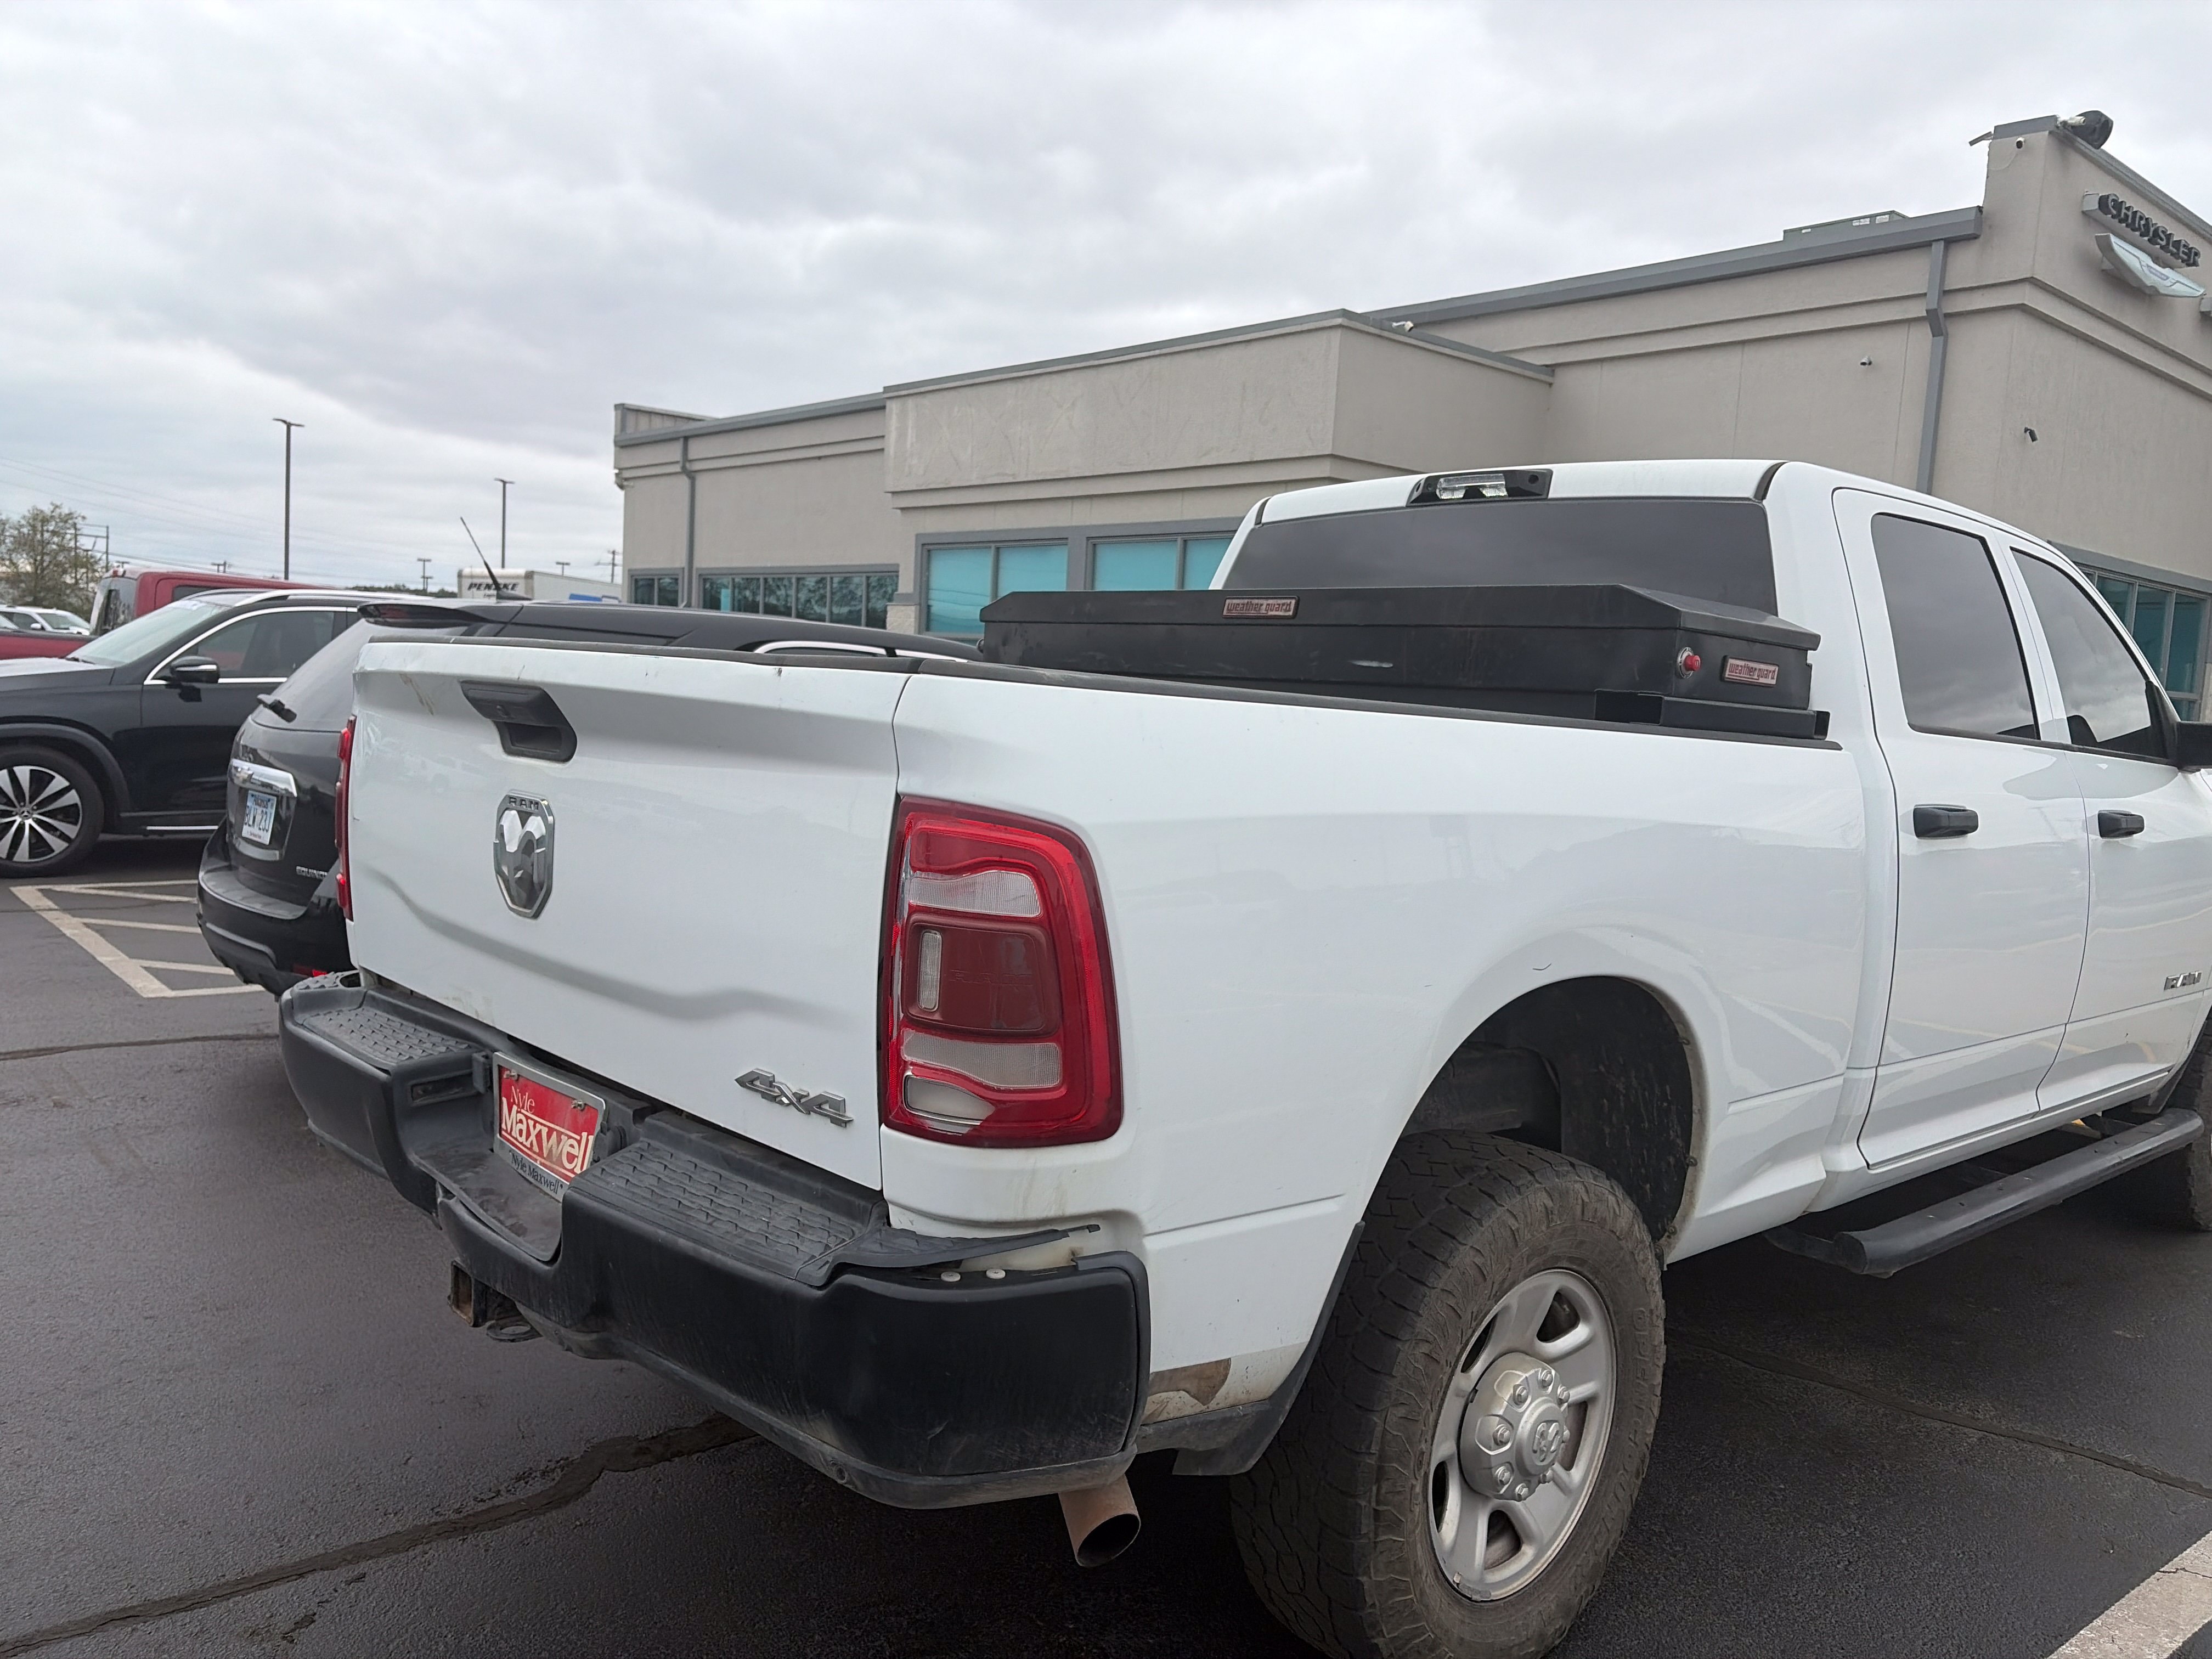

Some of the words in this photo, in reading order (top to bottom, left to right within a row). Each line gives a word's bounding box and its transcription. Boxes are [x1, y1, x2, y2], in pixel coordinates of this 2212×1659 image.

[2099, 194, 2200, 267] CHRYSLER
[1227, 601, 1263, 612] weather
[1265, 601, 1292, 614] guard
[1728, 663, 1757, 676] weather
[1757, 668, 1777, 680] guard
[509, 797, 539, 811] RAM
[511, 1086, 535, 1113] Nyle
[501, 1097, 594, 1173] Maxwell
